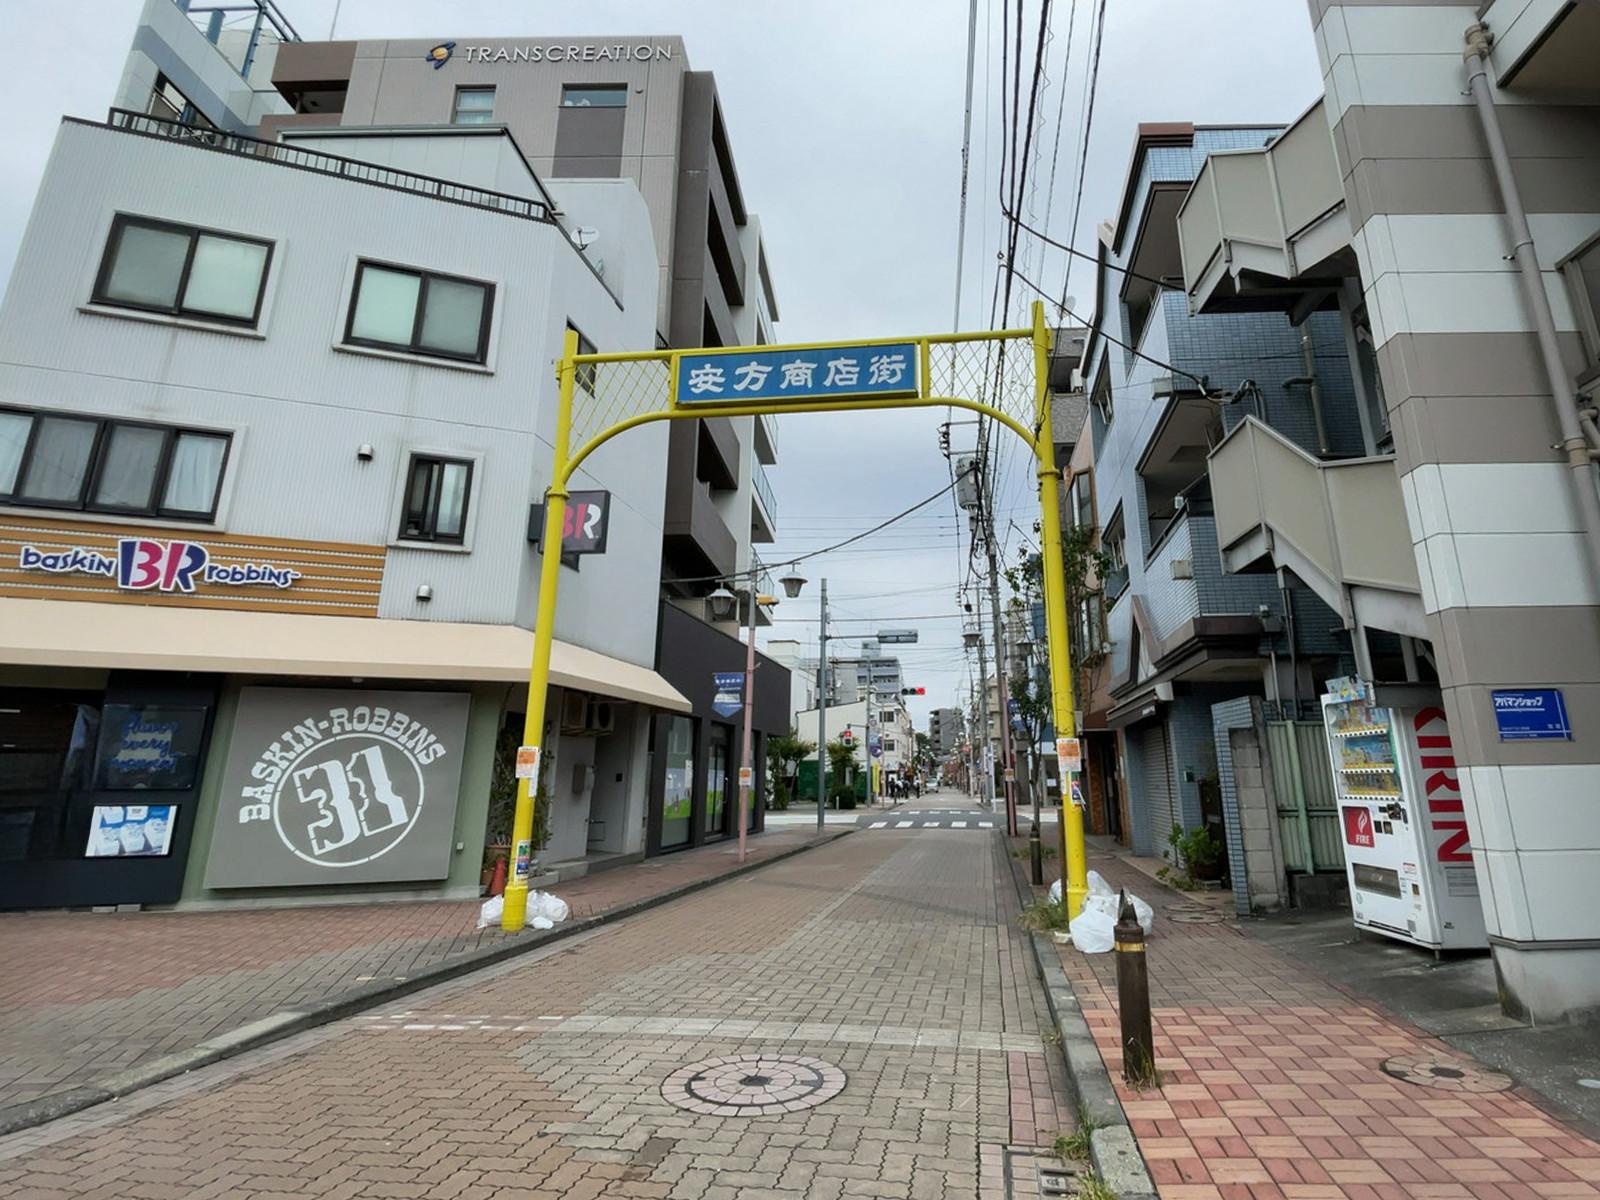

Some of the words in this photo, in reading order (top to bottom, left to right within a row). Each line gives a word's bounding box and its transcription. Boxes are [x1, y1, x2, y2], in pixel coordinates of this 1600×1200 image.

[465, 44, 672, 63] TRANSCREATION
[688, 354, 907, 394] 安方商店街
[20, 546, 116, 576] baskin
[117, 538, 210, 592] BR
[204, 563, 293, 588] robbins
[238, 705, 447, 824] BASKIN-ROBBINS
[292, 744, 409, 856] 31
[1355, 833, 1371, 845] FIRE
